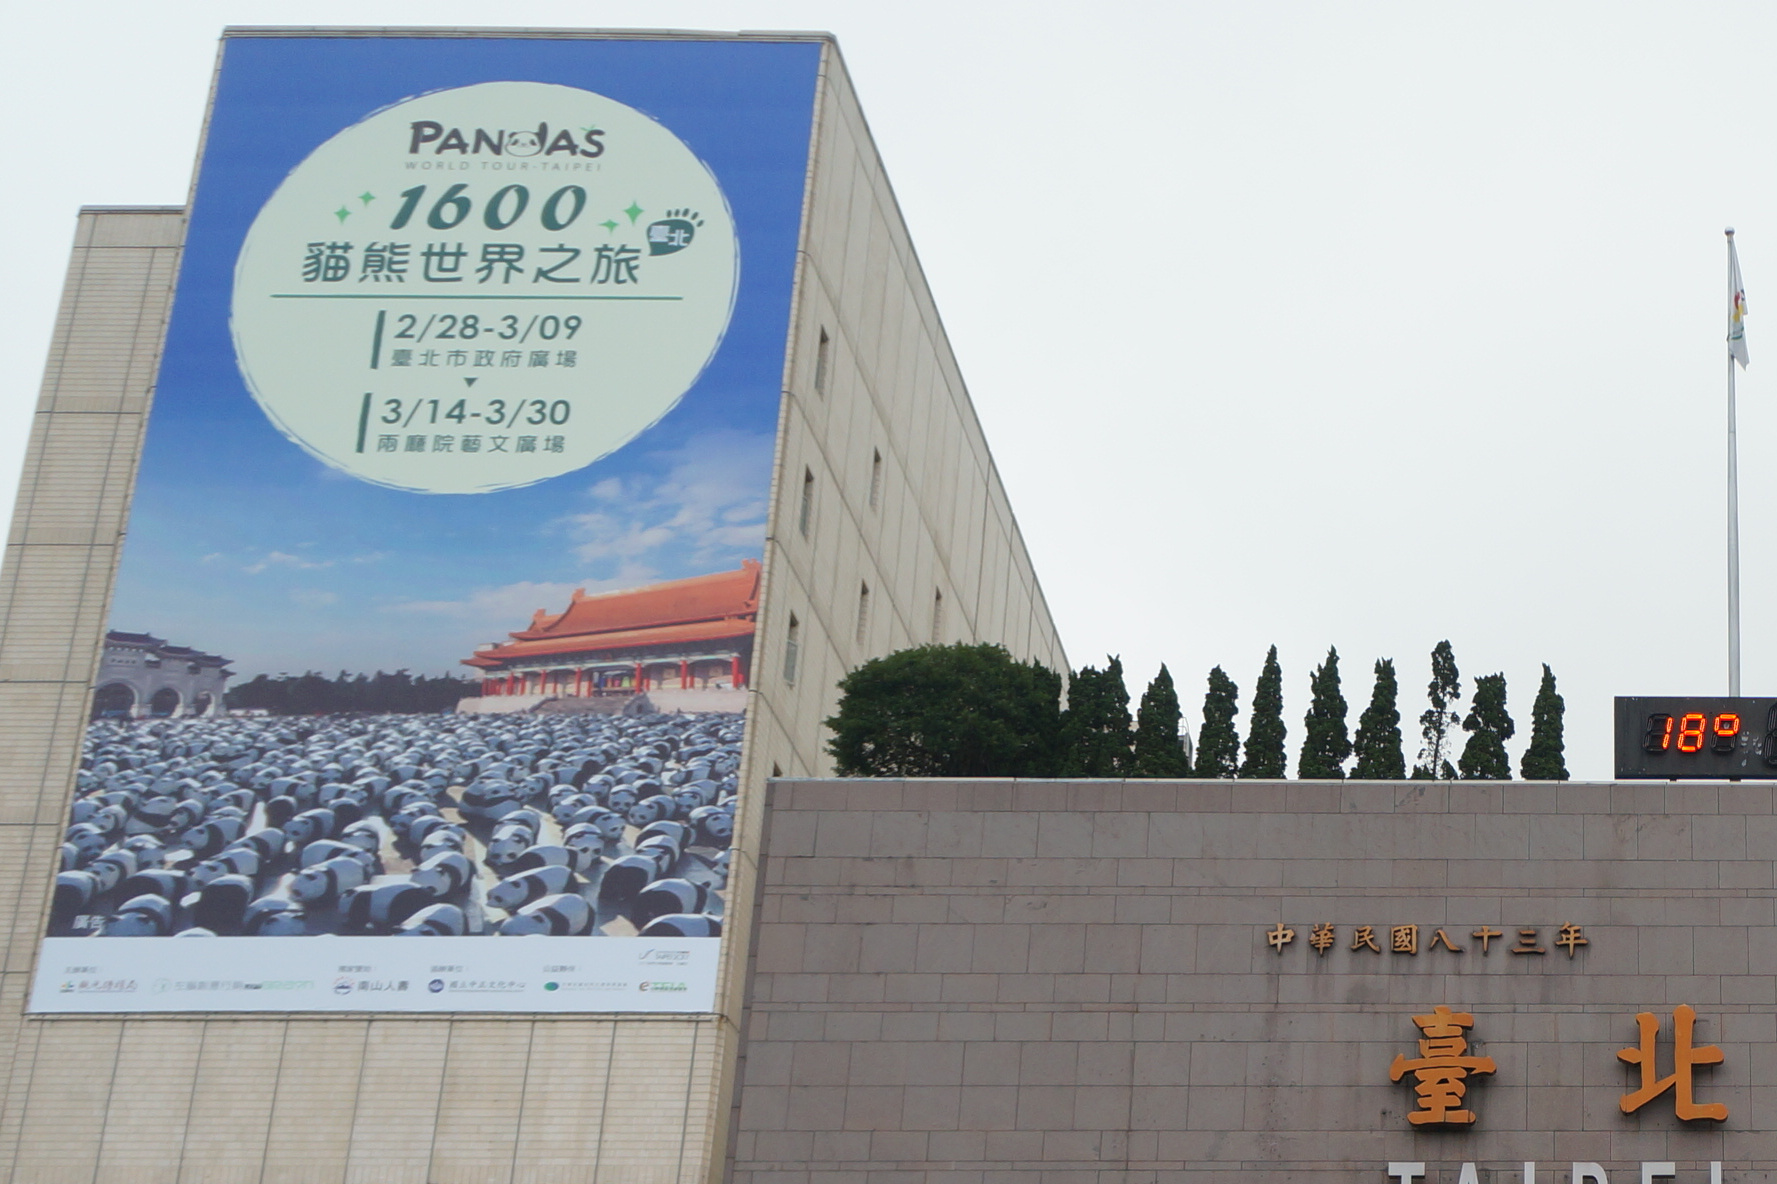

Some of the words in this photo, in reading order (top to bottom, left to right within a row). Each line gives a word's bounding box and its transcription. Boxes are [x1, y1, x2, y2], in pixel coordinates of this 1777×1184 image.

[408, 120, 605, 158] PANDAS
[404, 161, 470, 171] WORLD
[389, 182, 588, 231] 1600
[301, 241, 642, 285] 貓熊世界之旅
[393, 314, 583, 345] 2/28-3/09
[390, 348, 578, 368] 臺北市政府廣場
[380, 398, 571, 429] 3/14-3/30
[377, 434, 565, 454] 兩廳院藝文廣場
[1266, 919, 1588, 960] 中華民國八十三年
